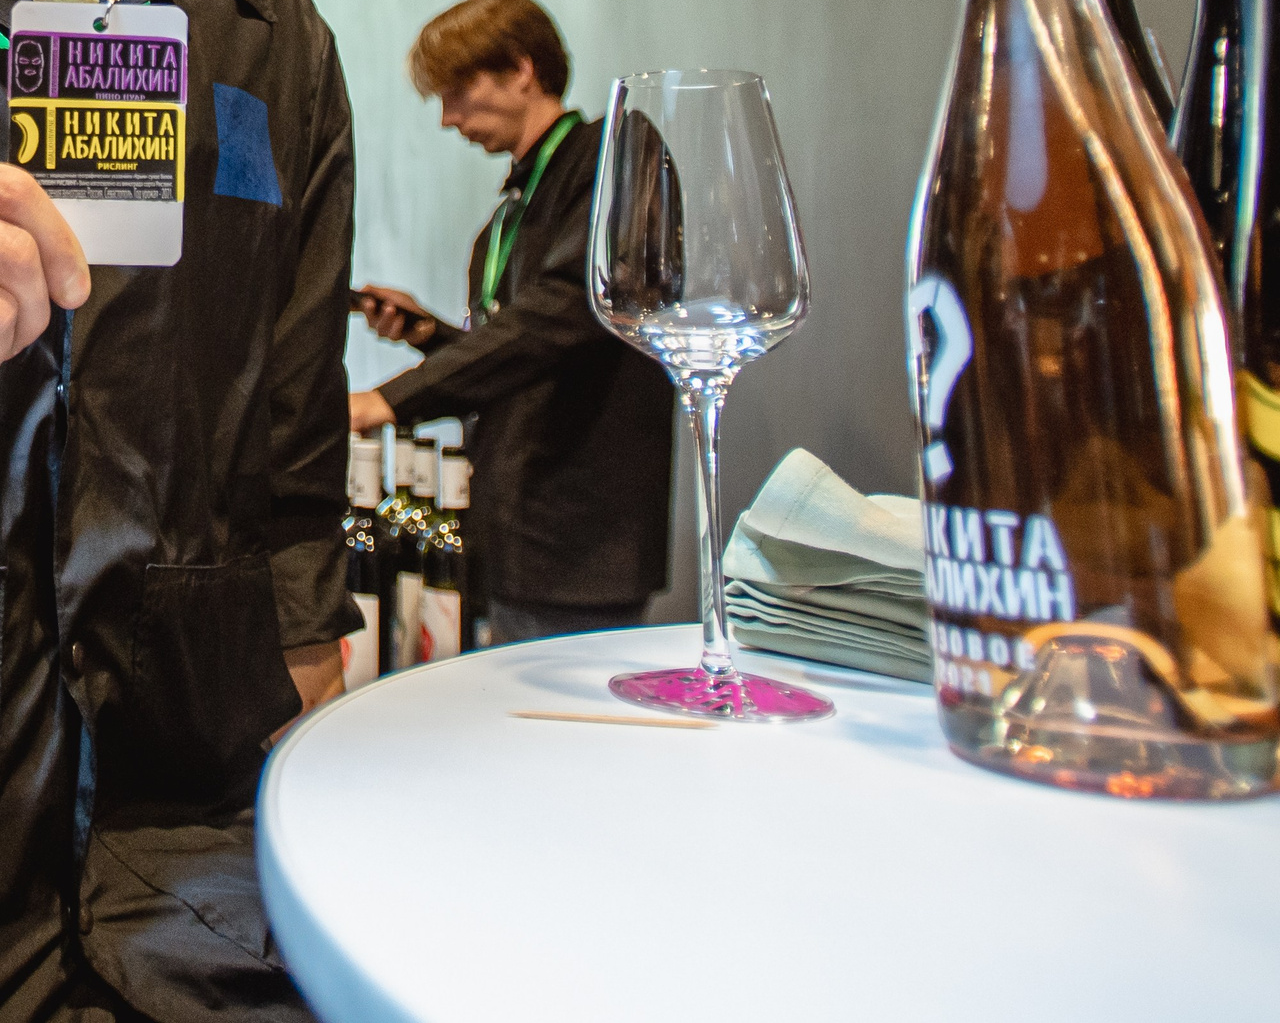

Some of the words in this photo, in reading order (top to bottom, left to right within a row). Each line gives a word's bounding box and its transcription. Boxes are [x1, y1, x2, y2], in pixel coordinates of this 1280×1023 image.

[68, 40, 178, 69] НИКИТА
[64, 65, 178, 93] АБАЛИХИН
[64, 111, 175, 137] НИКИТА
[61, 135, 175, 161] АБАЛИХИН
[97, 162, 138, 171] РИСЛИНГ
[923, 503, 1066, 571] КИТА
